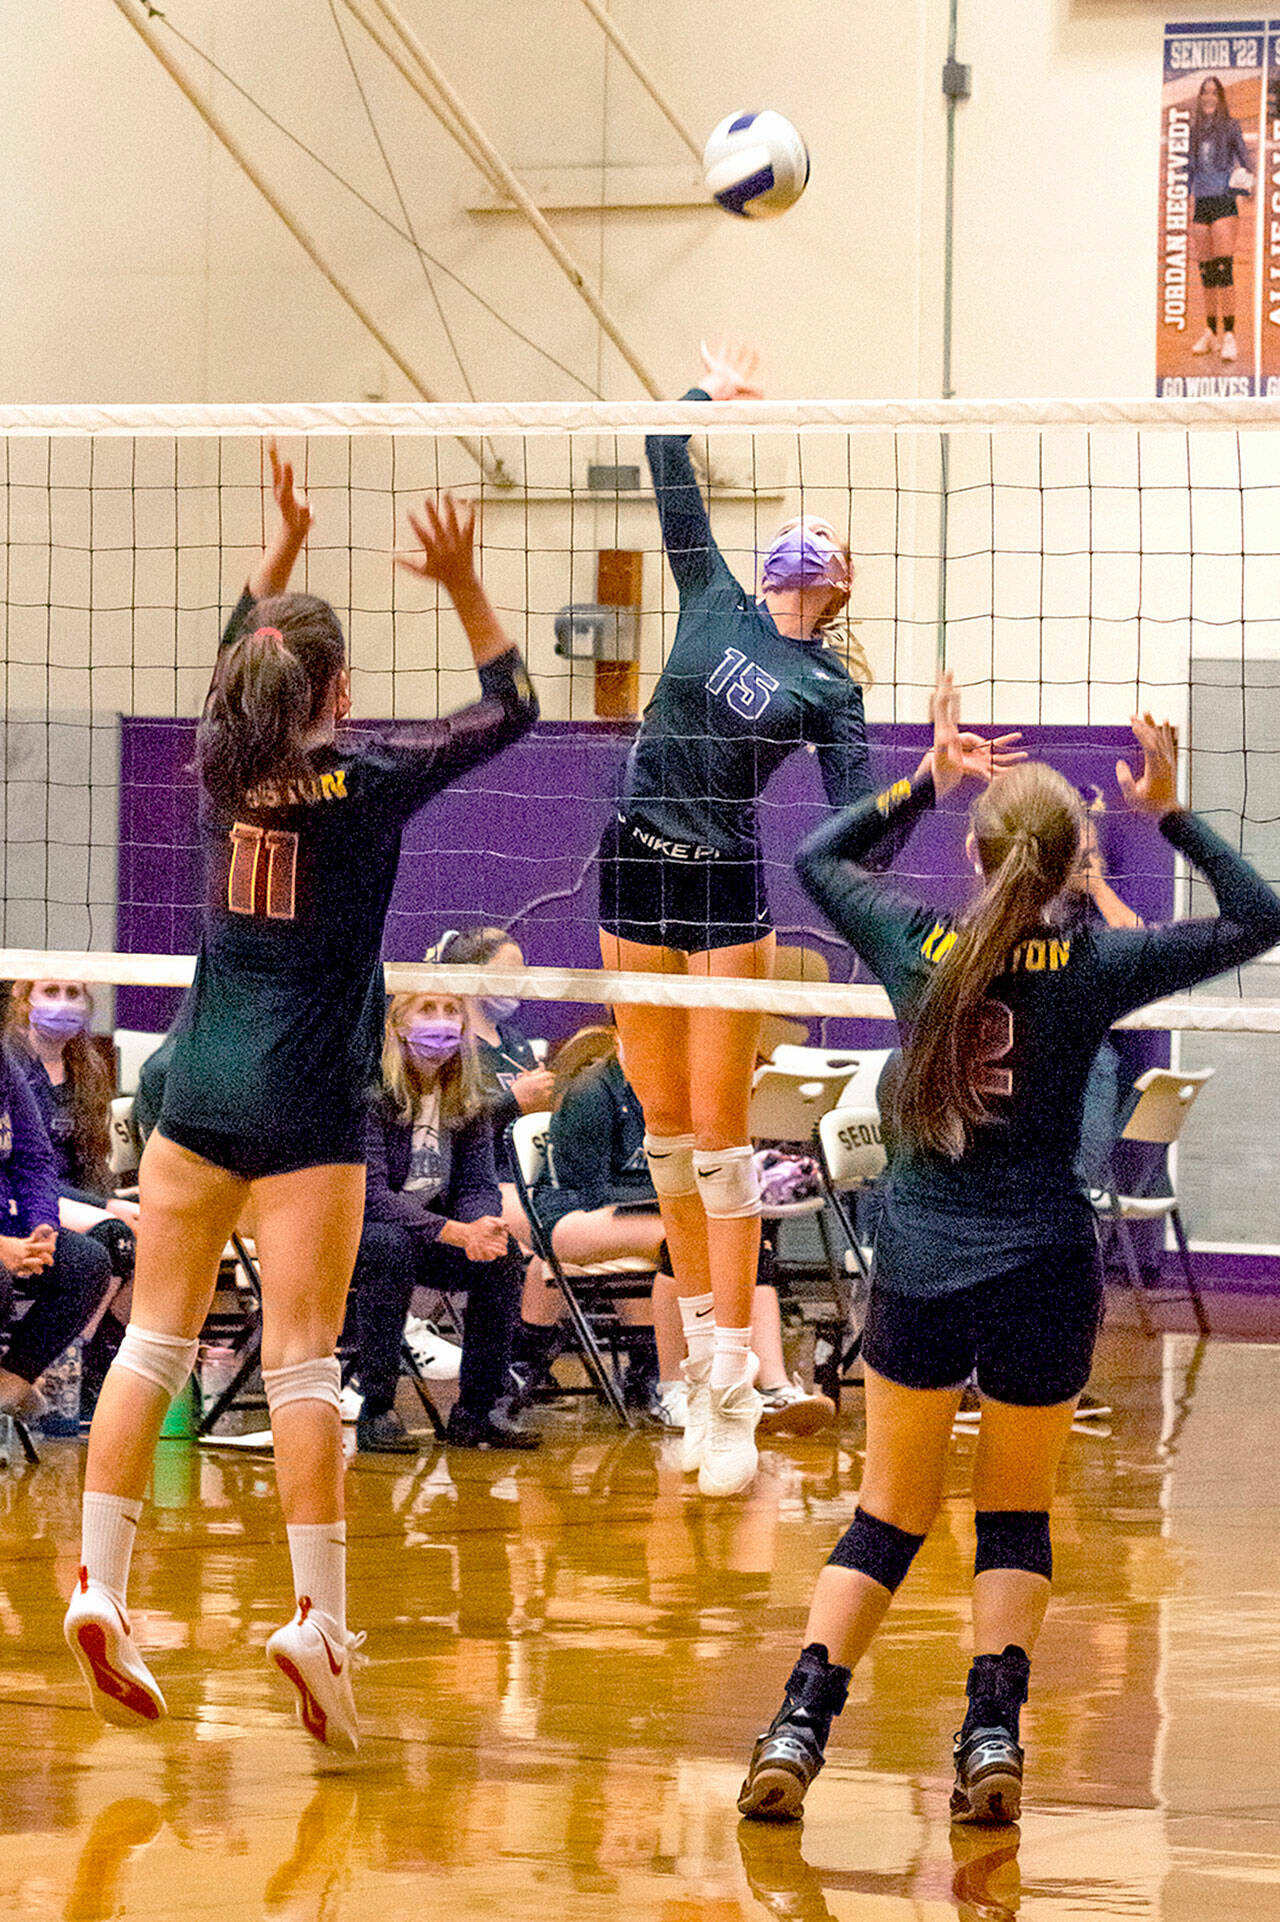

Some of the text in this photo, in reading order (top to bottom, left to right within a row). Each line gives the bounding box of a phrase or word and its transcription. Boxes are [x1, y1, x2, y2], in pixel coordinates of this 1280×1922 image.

[1170, 40, 1230, 69] SENIOR
[1233, 39, 1258, 67] '22
[1164, 108, 1190, 330] JORDAN HEGTVEDT
[1186, 376, 1249, 398] WOLVES
[705, 646, 780, 720] 15
[632, 826, 691, 859] NIKE
[228, 821, 299, 920] 11
[837, 1123, 882, 1151] SEQU
